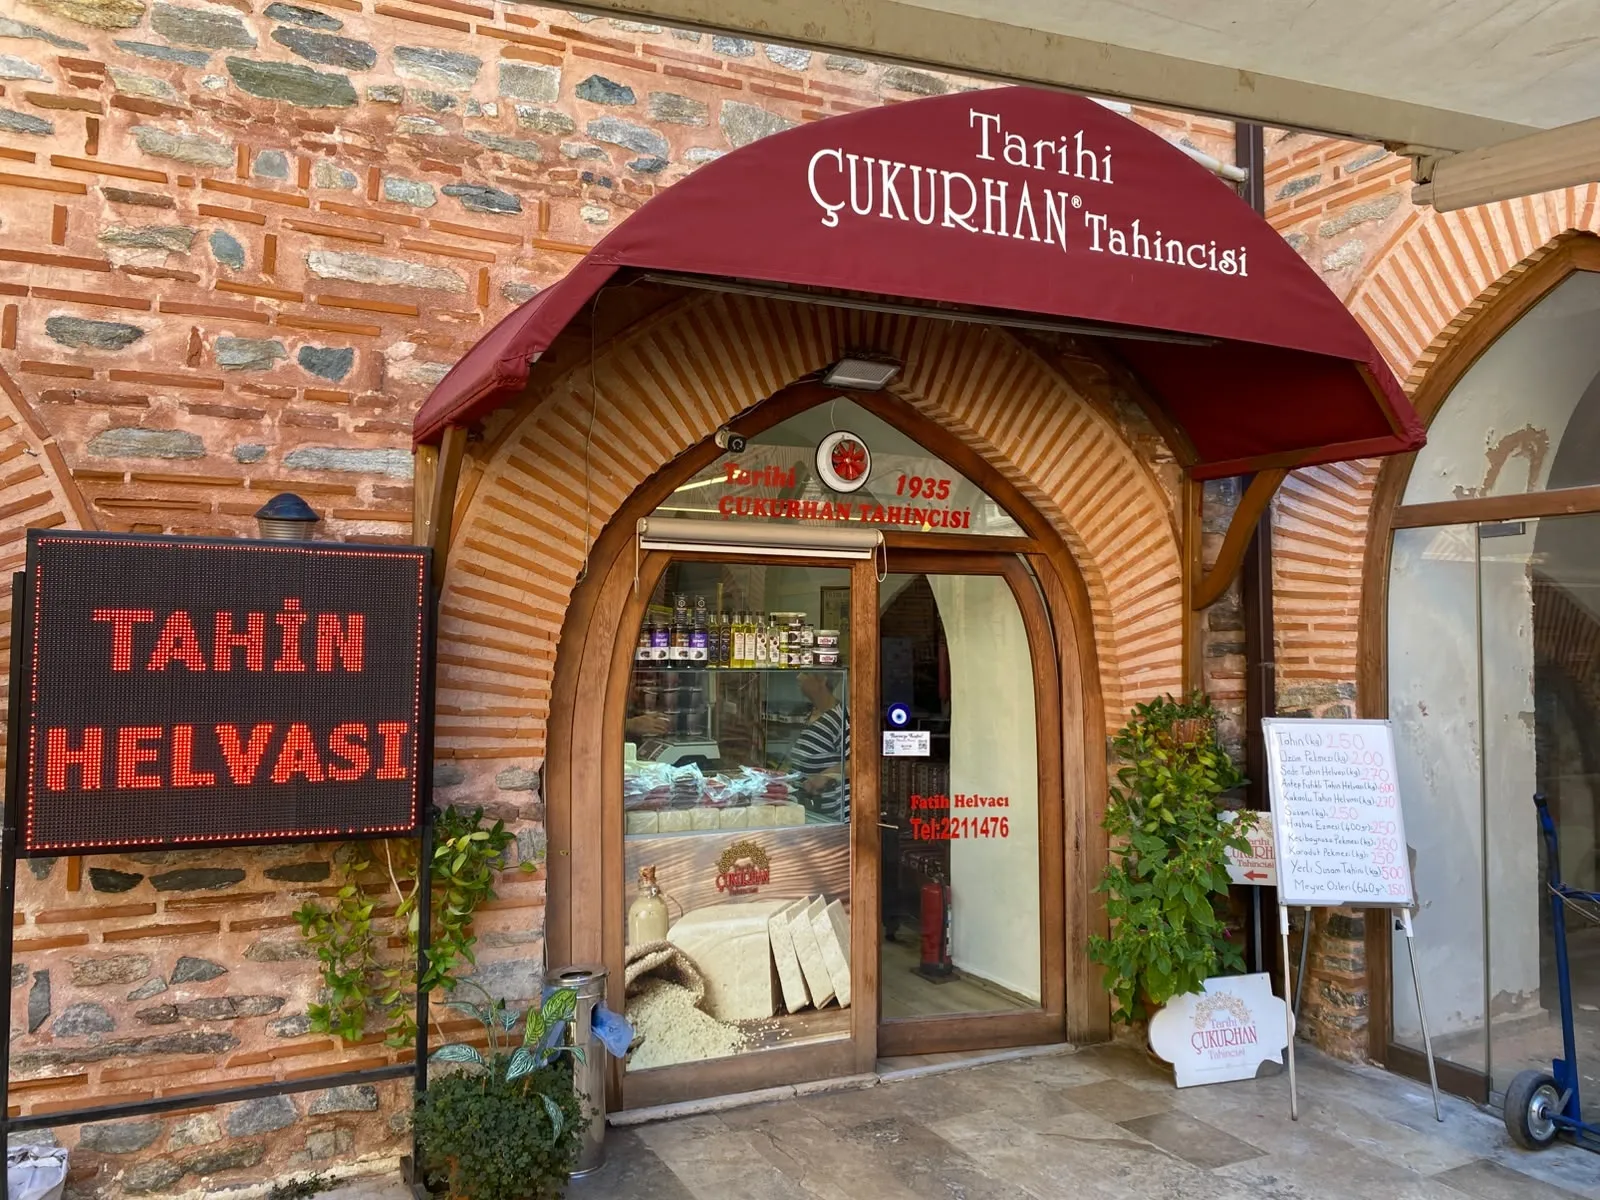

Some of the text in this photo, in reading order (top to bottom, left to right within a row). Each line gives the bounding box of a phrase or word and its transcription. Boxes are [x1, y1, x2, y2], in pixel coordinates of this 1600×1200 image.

[969, 107, 1114, 184] Tarihi
[1084, 211, 1249, 277] Tahincisi
[722, 462, 797, 489] Tarihi
[895, 474, 952, 501] 1935
[718, 495, 972, 529] ÇUKURHAN TAHİNCİSİ
[91, 596, 366, 672] TAHİN
[1326, 733, 1365, 750] 250
[45, 721, 410, 792] HELVASI
[1350, 750, 1384, 767] 200
[911, 794, 1009, 809] Fatih Helvacı
[1328, 806, 1358, 820] 250
[909, 816, 1009, 840] Tel:2211476
[1370, 851, 1395, 865] 250
[1381, 865, 1405, 880] 500
[1294, 879, 1325, 895] Meyve
[1190, 1026, 1258, 1055] ÇUKURHAN
